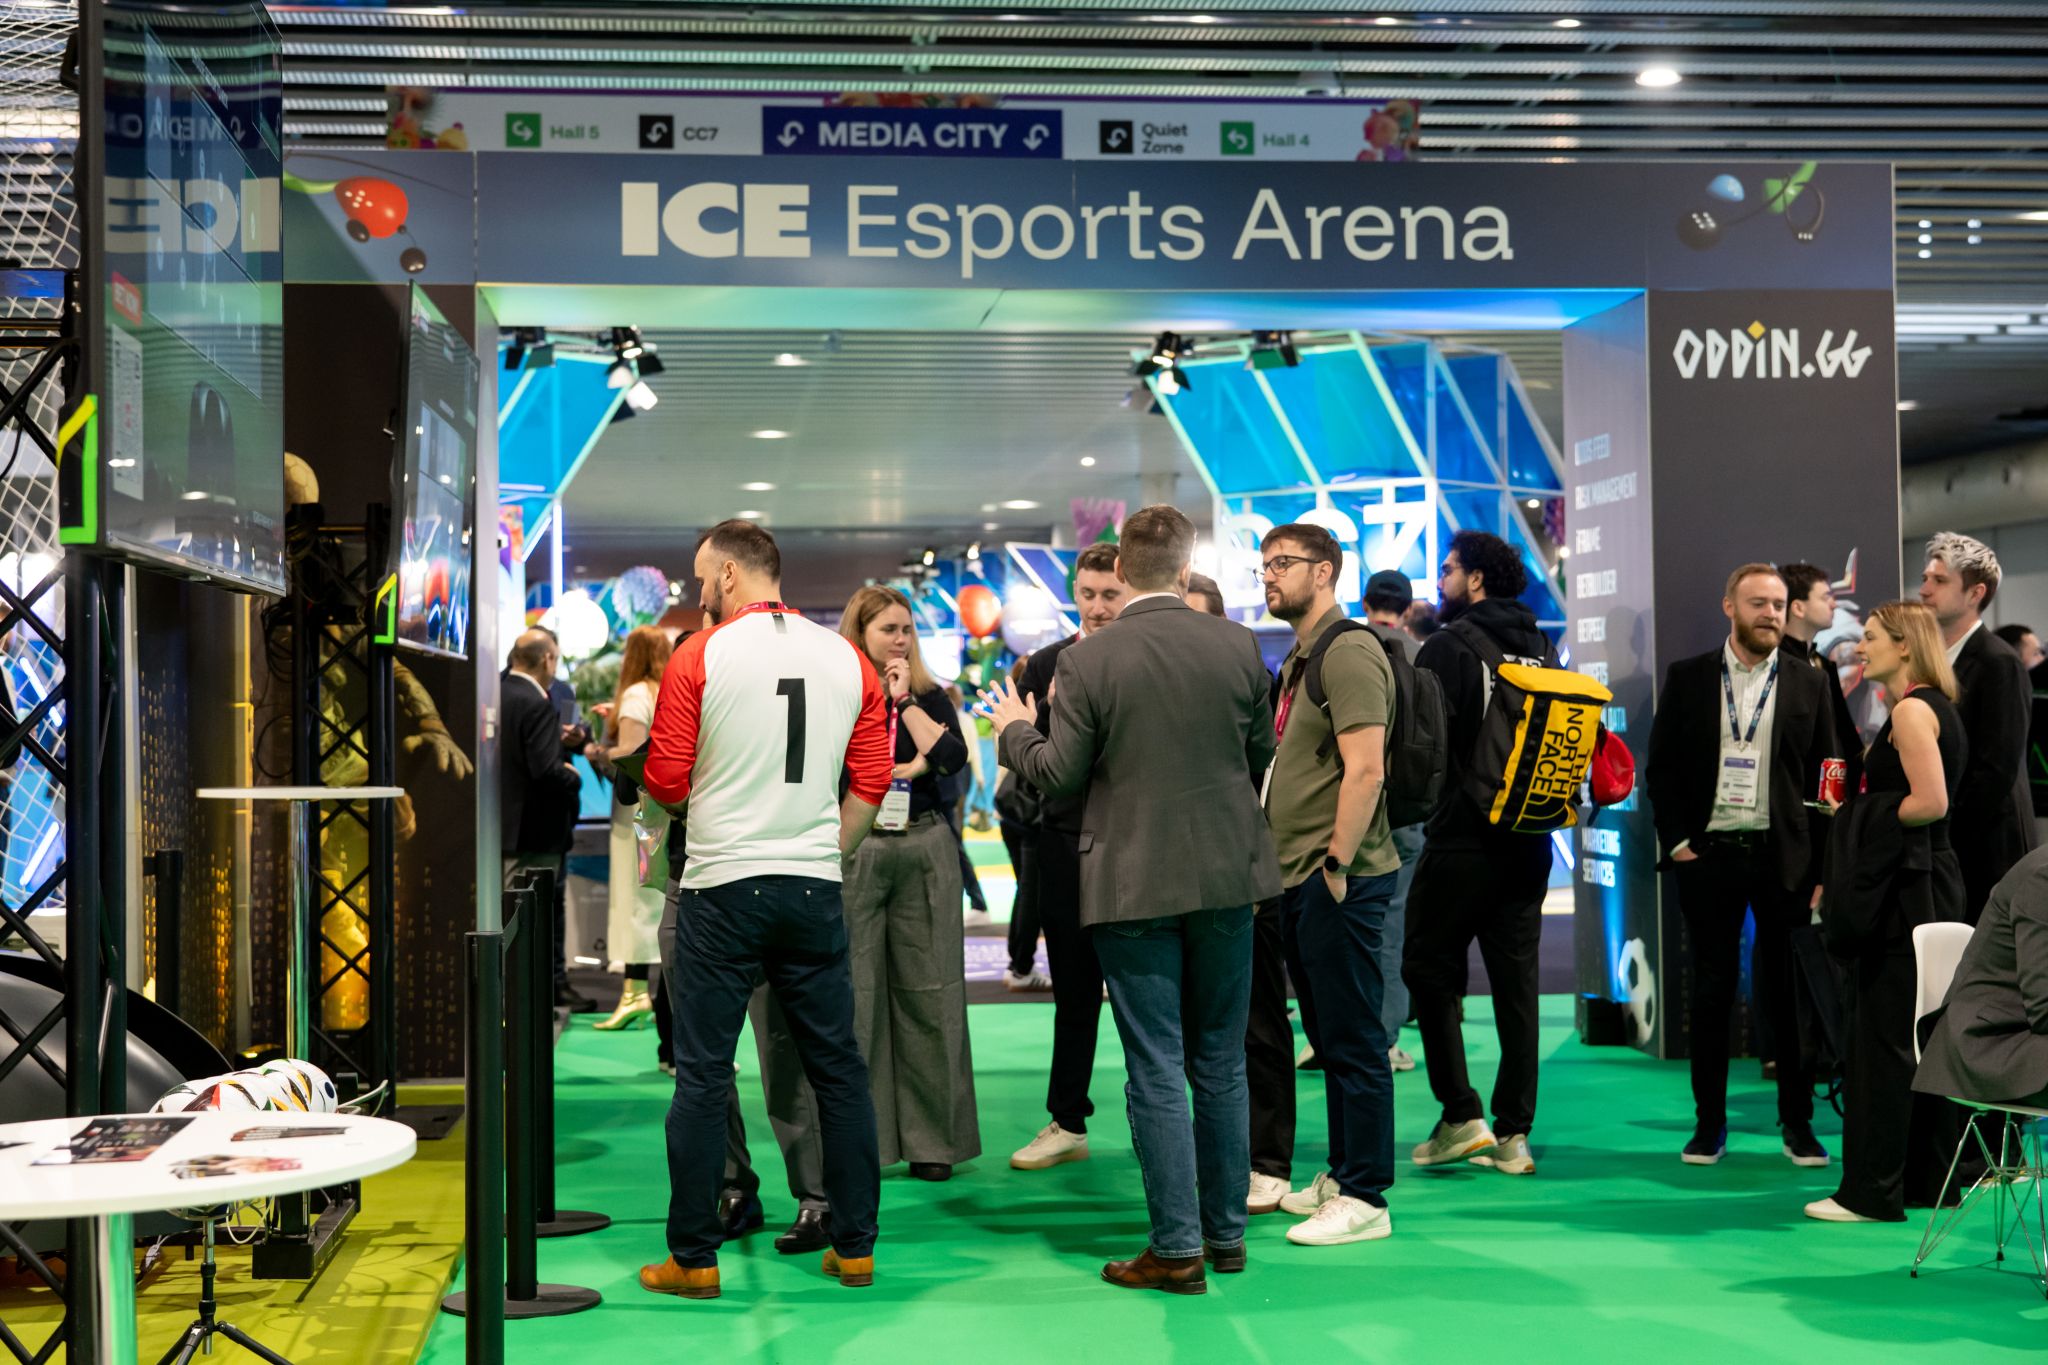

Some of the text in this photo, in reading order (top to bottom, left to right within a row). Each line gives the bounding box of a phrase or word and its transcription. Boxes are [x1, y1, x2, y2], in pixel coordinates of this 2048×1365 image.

[550, 124, 601, 141] Hall 5
[683, 126, 719, 142] CC7
[818, 121, 1009, 149] MEDIA CITY
[1141, 123, 1189, 140] Quiet
[1262, 132, 1310, 148] Hall 4
[1141, 140, 1185, 155] Zone
[620, 181, 1515, 279] ICE Esports Arena
[776, 677, 806, 784] 1
[1531, 729, 1565, 793] FACE
[1550, 706, 1585, 796] NORTH
